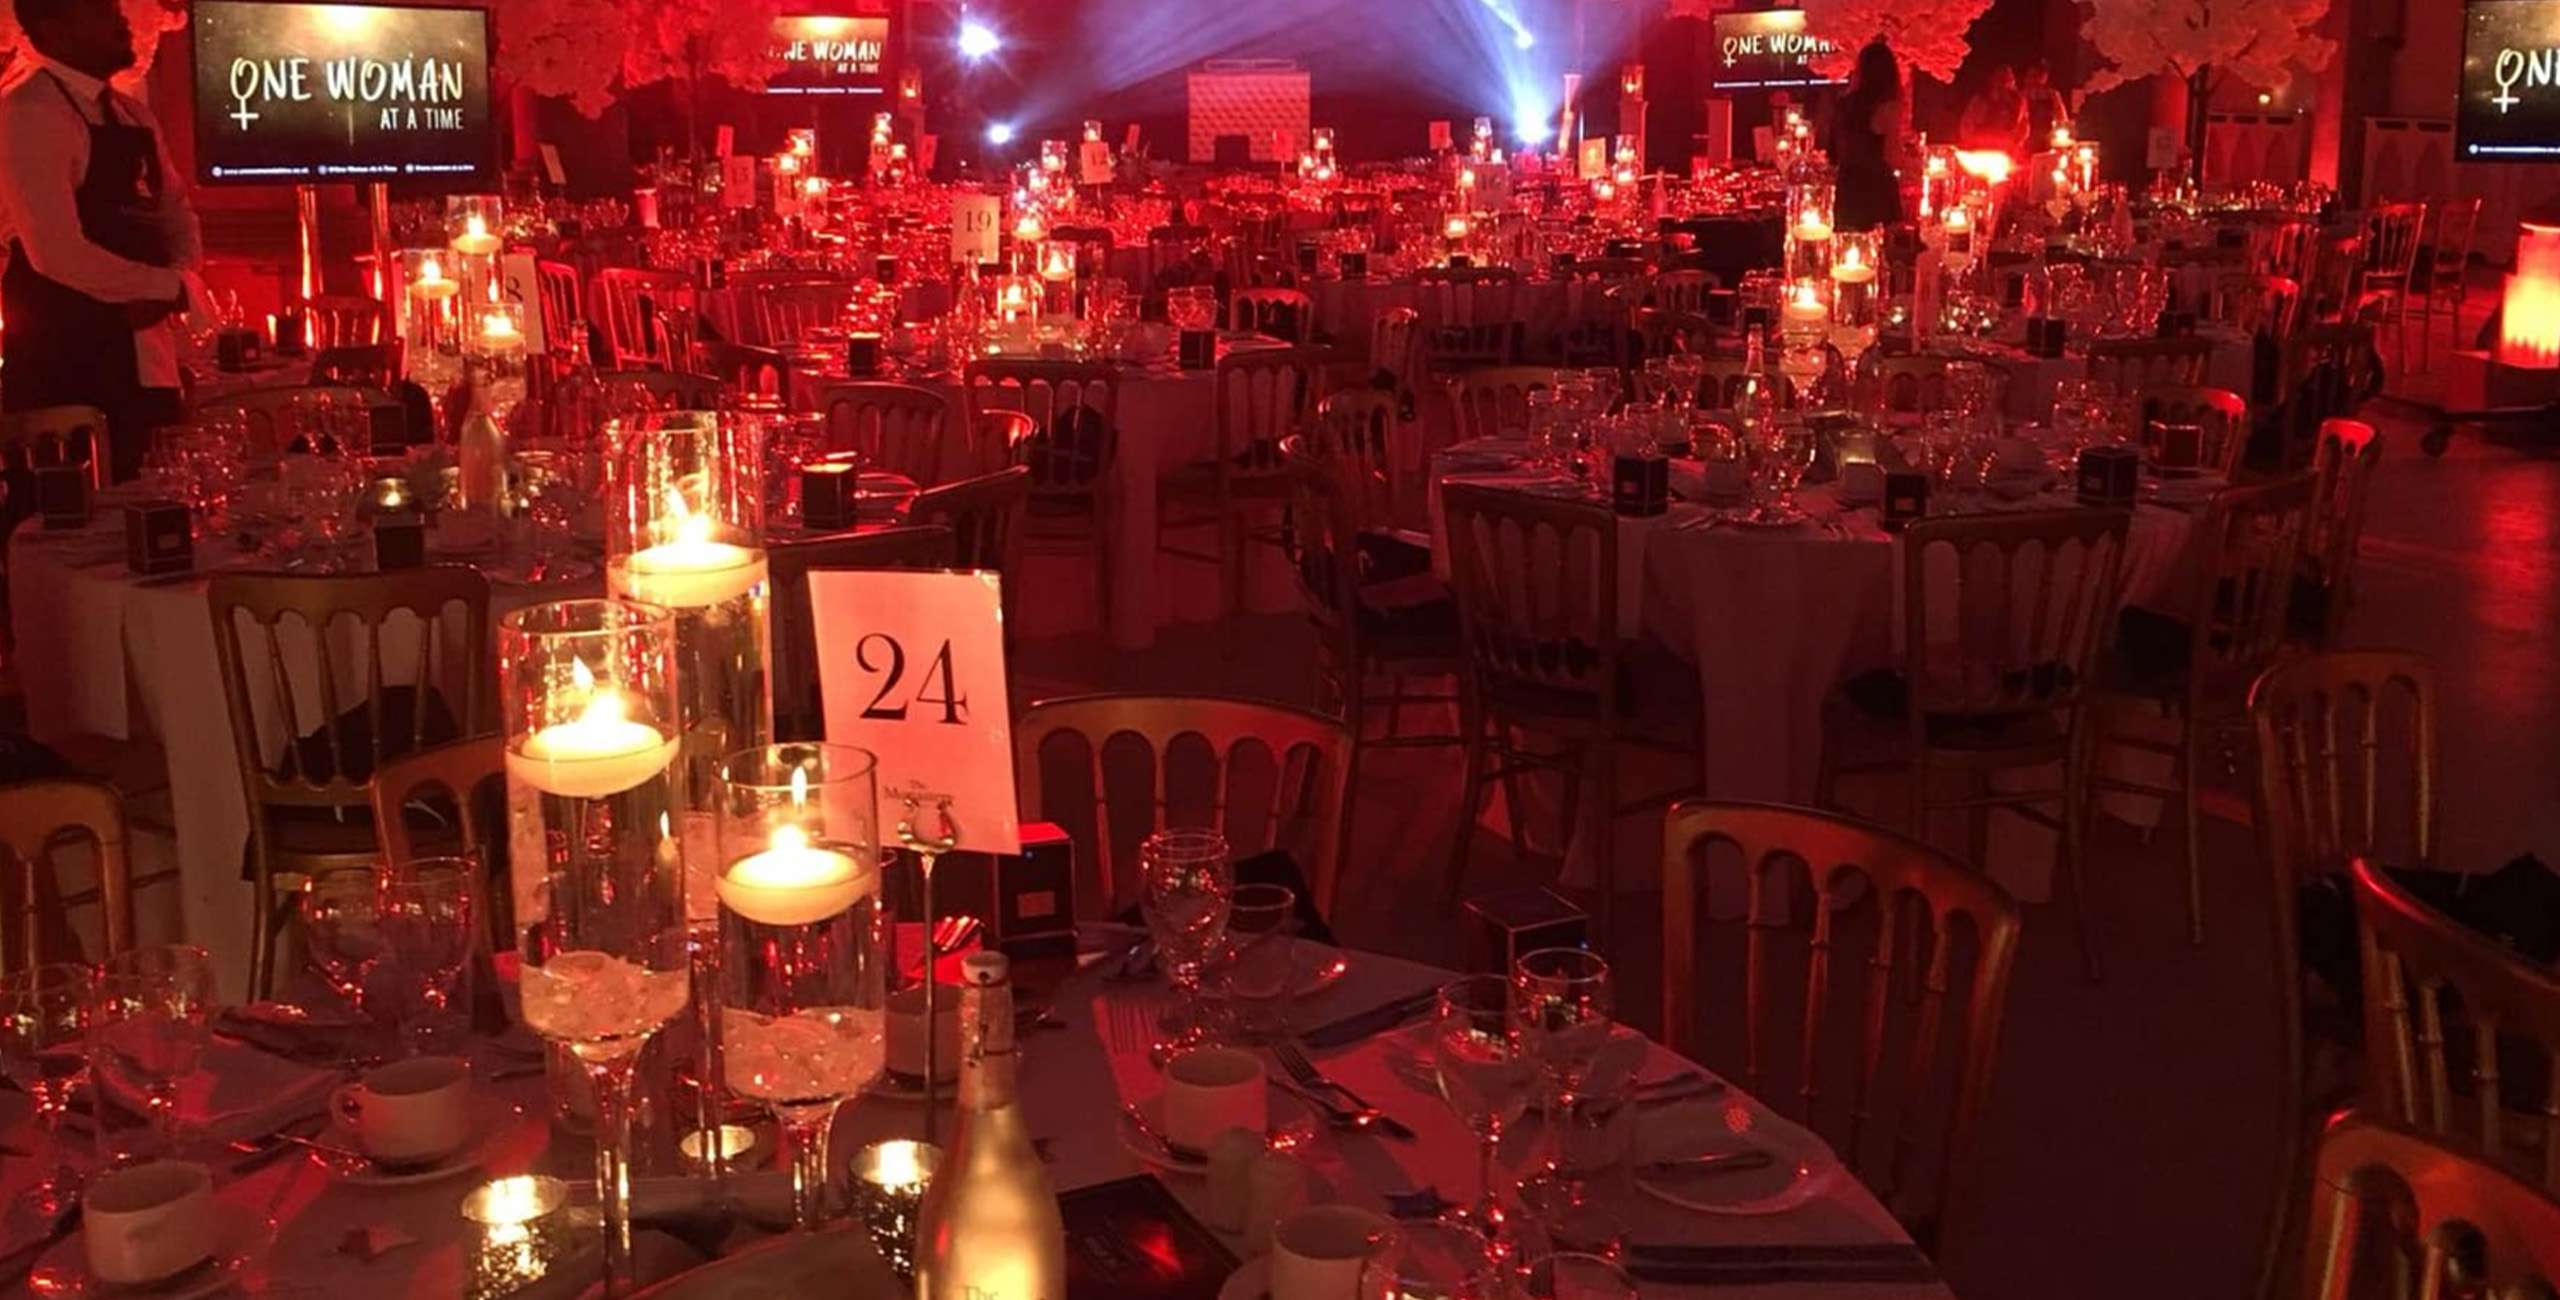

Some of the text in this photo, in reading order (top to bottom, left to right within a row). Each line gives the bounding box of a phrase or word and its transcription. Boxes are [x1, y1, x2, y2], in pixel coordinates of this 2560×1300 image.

[813, 38, 881, 61] WOMAN
[1723, 34, 1763, 68] ONE
[850, 63, 858, 73] A
[2492, 48, 2560, 113] ON
[230, 55, 462, 131] ONE WOMAN
[380, 108, 463, 130] AT A TIME
[966, 210, 992, 232] 19
[855, 632, 969, 726] 24
